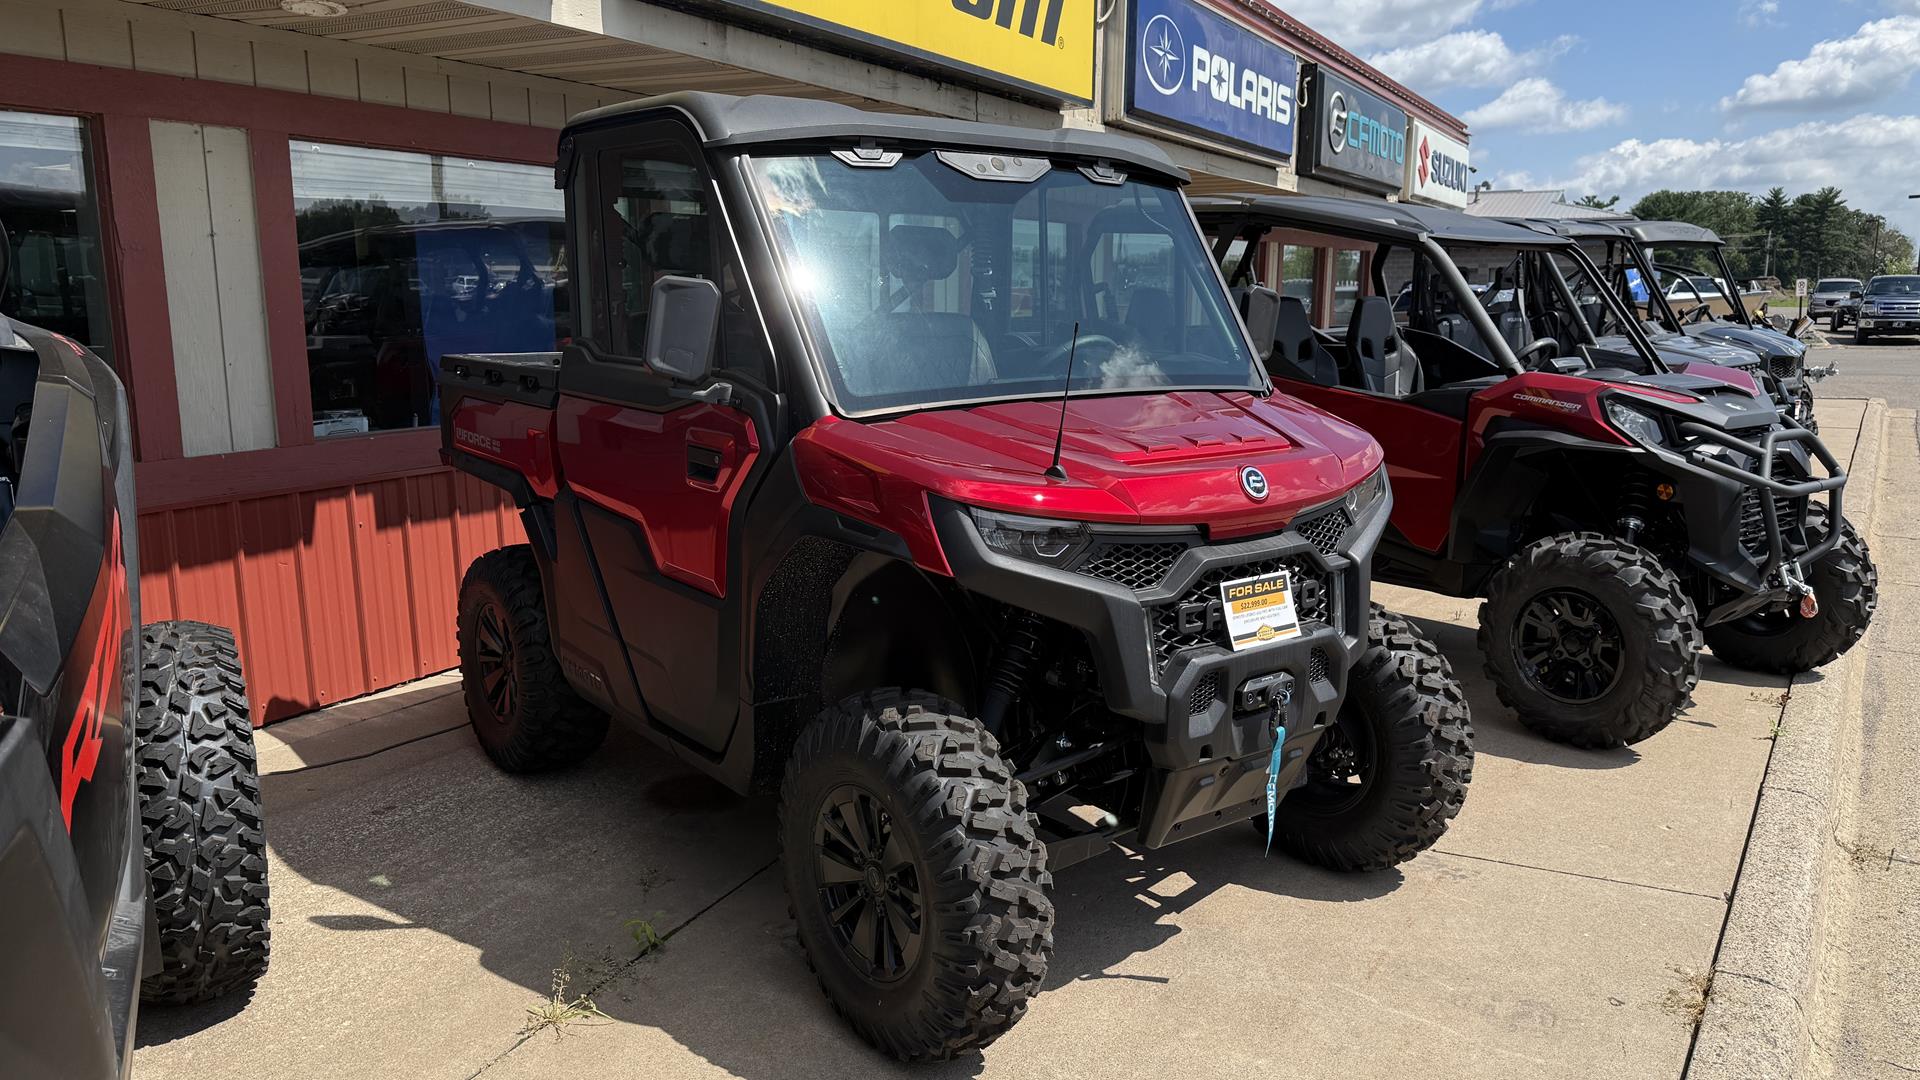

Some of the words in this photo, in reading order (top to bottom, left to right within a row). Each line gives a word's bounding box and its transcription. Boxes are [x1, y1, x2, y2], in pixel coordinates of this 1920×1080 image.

[1192, 45, 1292, 125] POLARIS
[1346, 111, 1405, 165] CFMOTO
[1431, 150, 1468, 193] SUZUKI
[1513, 393, 1582, 410] COMMANDER
[1229, 585, 1253, 599] FOR
[1255, 578, 1284, 594] SALE
[1241, 598, 1268, 610] $22,999.00
